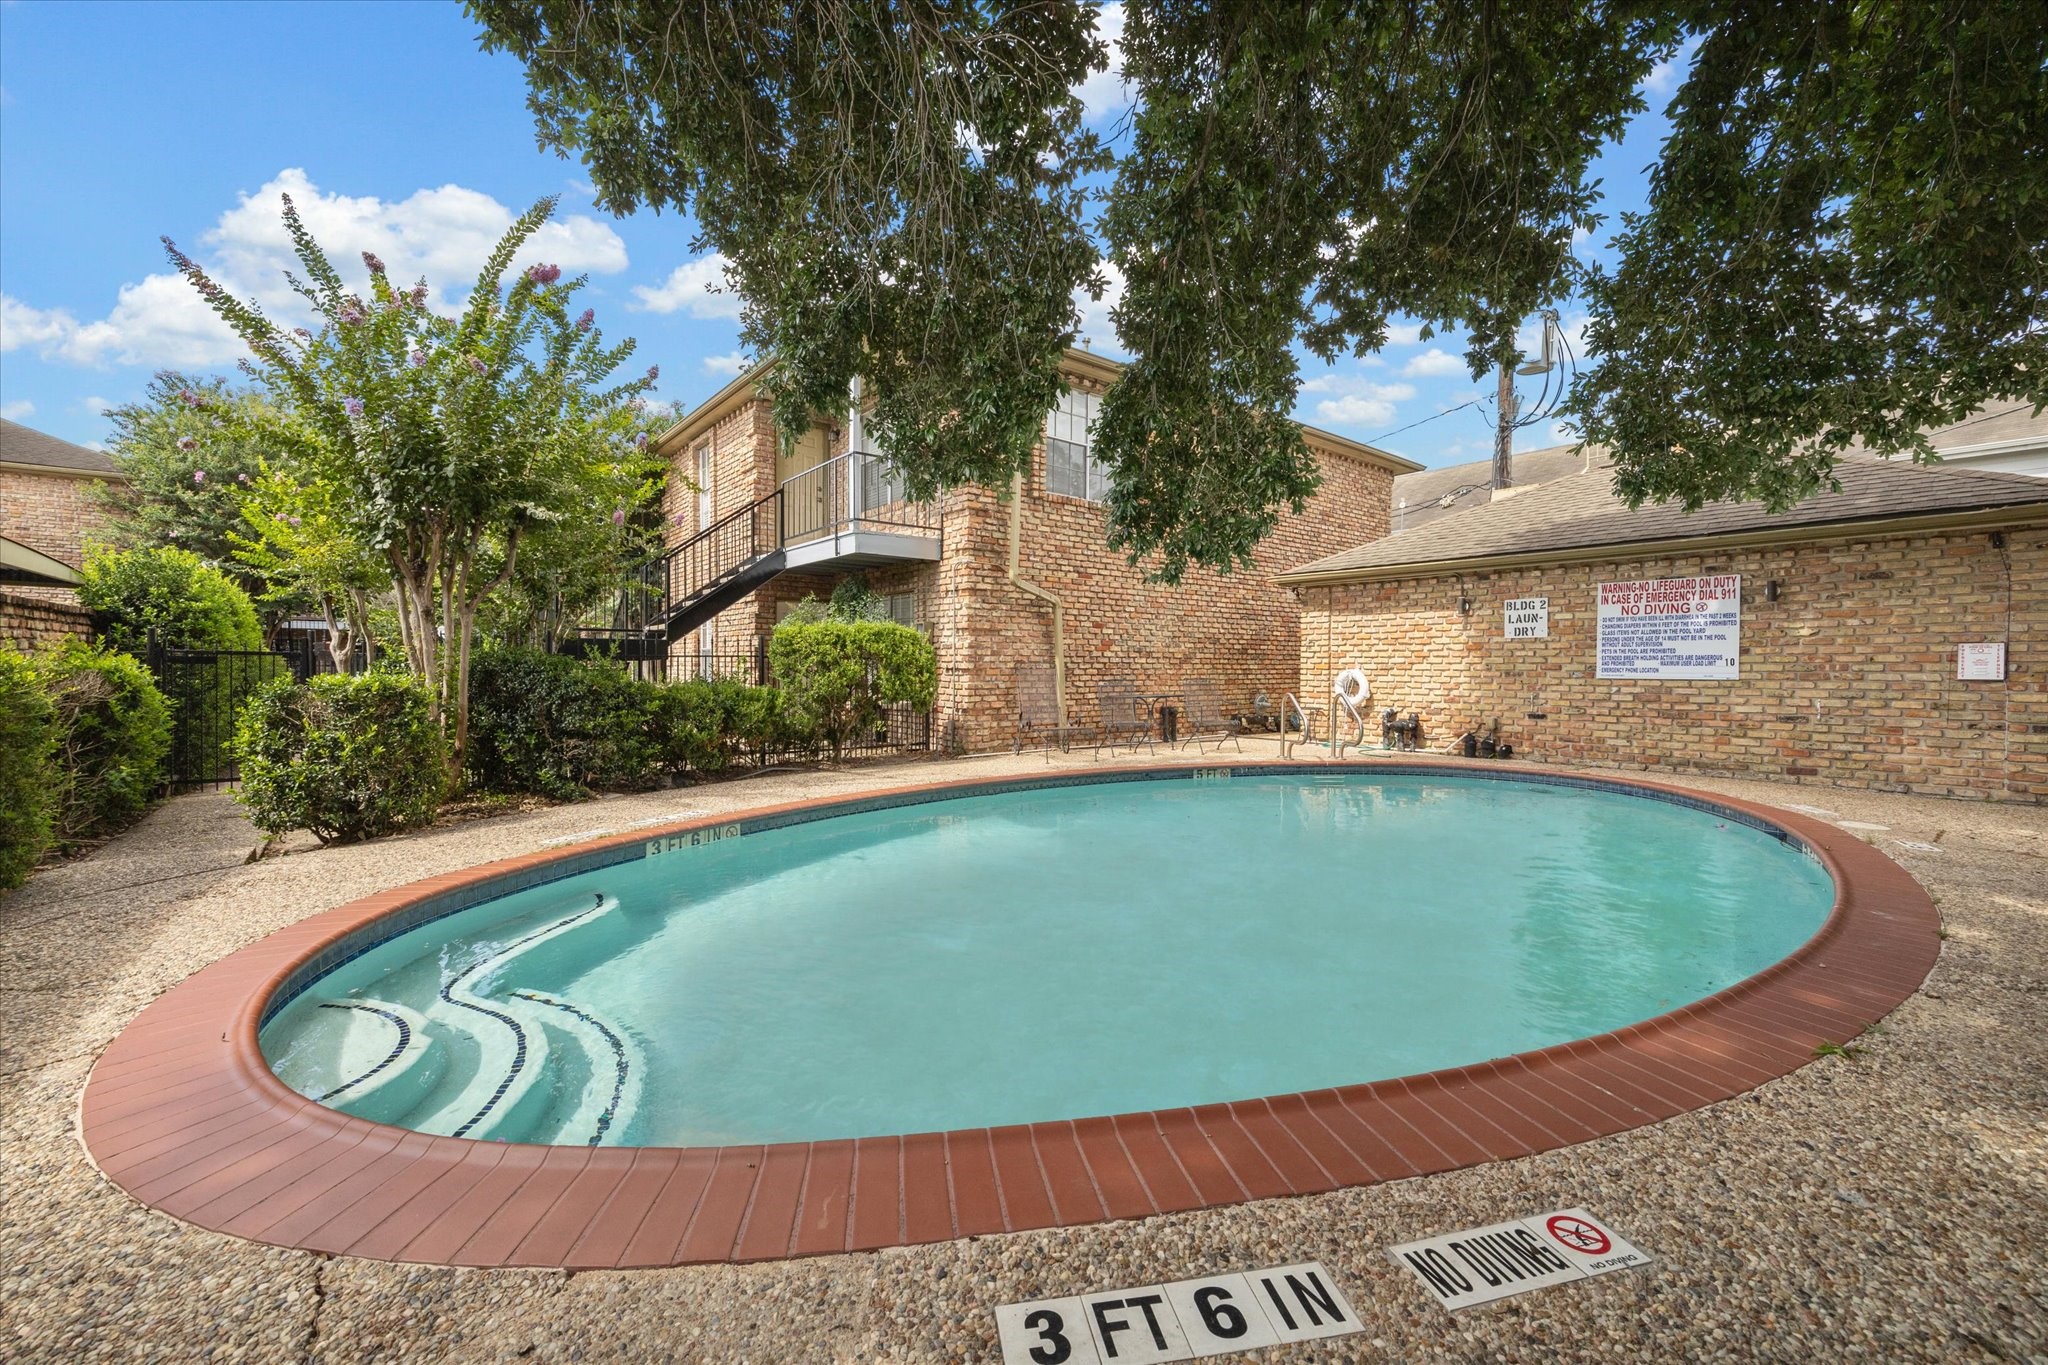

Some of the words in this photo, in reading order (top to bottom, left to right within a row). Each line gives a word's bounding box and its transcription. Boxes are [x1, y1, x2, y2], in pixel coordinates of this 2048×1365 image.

[1601, 581, 1649, 594] WARNING-NO
[1652, 579, 1697, 591] LIFEGUARD
[1699, 578, 1711, 589] ON
[1714, 576, 1737, 588] DUTY
[1601, 594, 1609, 605] IN
[1611, 593, 1631, 605] CASE
[1633, 593, 1644, 603] OF
[1646, 590, 1697, 603] EMERGENCY
[1699, 589, 1719, 600] DIAL
[1721, 588, 1736, 600] 911
[1506, 601, 1535, 611] BLDG
[1540, 600, 1546, 609] 2
[1621, 605, 1640, 615] NO
[1644, 603, 1690, 615] DIVING
[1509, 614, 1543, 624] LAUN-
[1514, 627, 1536, 636] DRY
[1725, 658, 1735, 666] 10
[1207, 769, 1217, 778] FT
[652, 841, 661, 855] 3
[668, 835, 685, 851] FT
[692, 832, 700, 846] 6
[707, 828, 720, 842] IN
[1403, 1248, 1474, 1298] NO
[1447, 1228, 1571, 1287] DIVING
[1589, 1261, 1605, 1270] NO
[1605, 1254, 1638, 1267] DIVING
[1024, 1309, 1072, 1365] 3
[1091, 1294, 1169, 1358] FT
[1193, 1286, 1248, 1339] 6
[1260, 1271, 1347, 1331] IN
